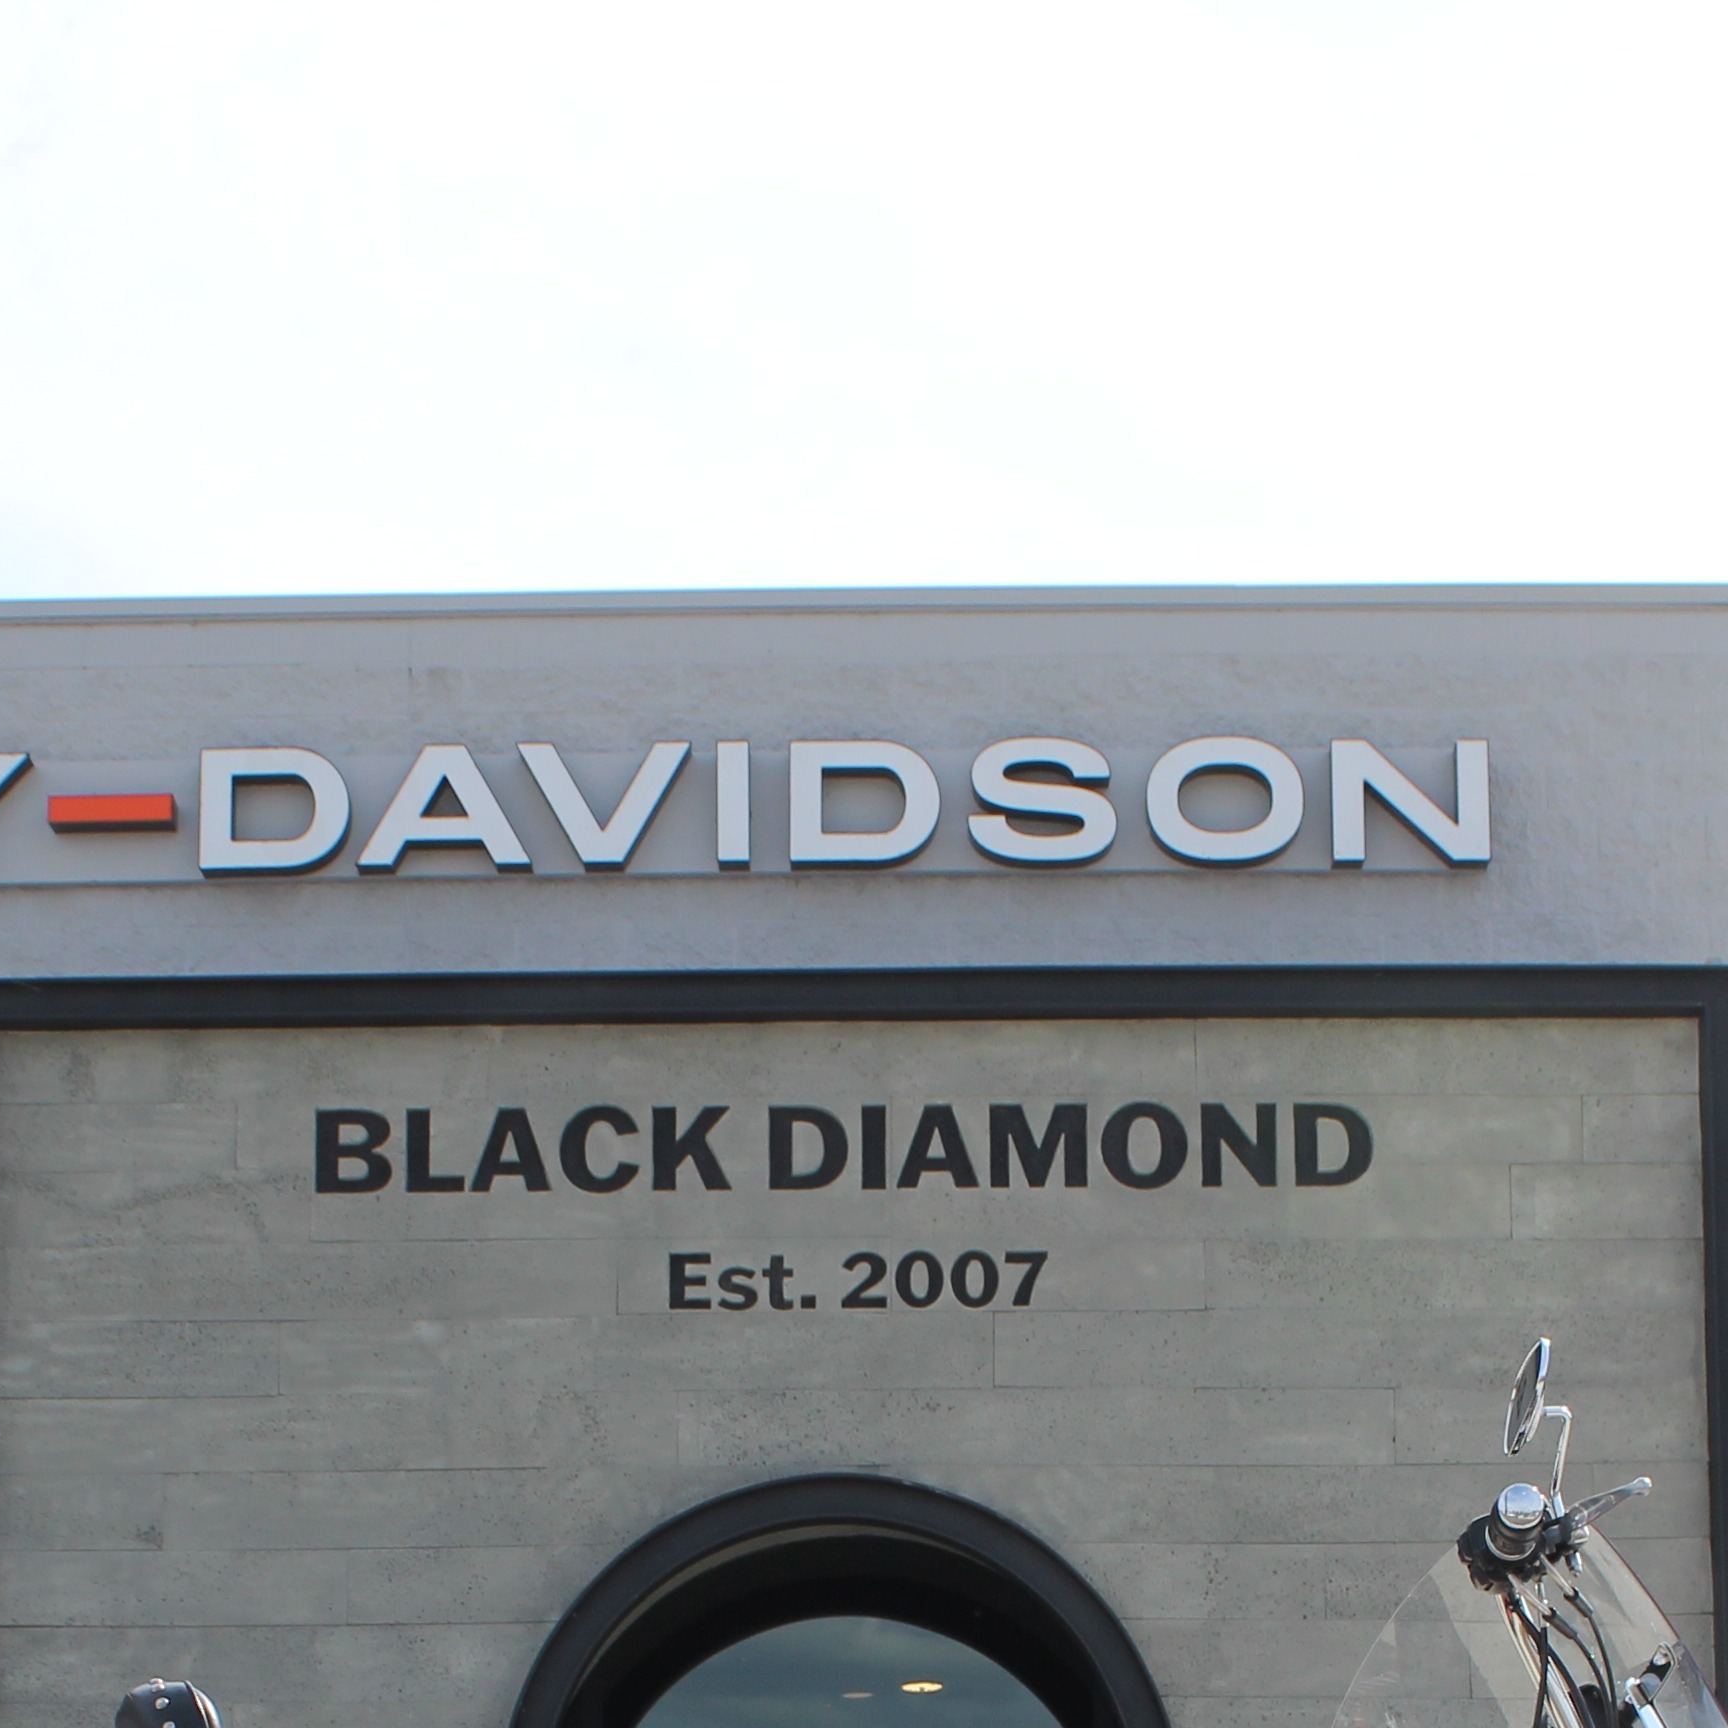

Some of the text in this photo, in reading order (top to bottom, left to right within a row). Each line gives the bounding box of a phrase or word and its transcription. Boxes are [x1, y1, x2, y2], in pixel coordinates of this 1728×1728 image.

[313, 1100, 1374, 1195] BLACK DIAMOND
[667, 1250, 1049, 1312] Est. 2007
